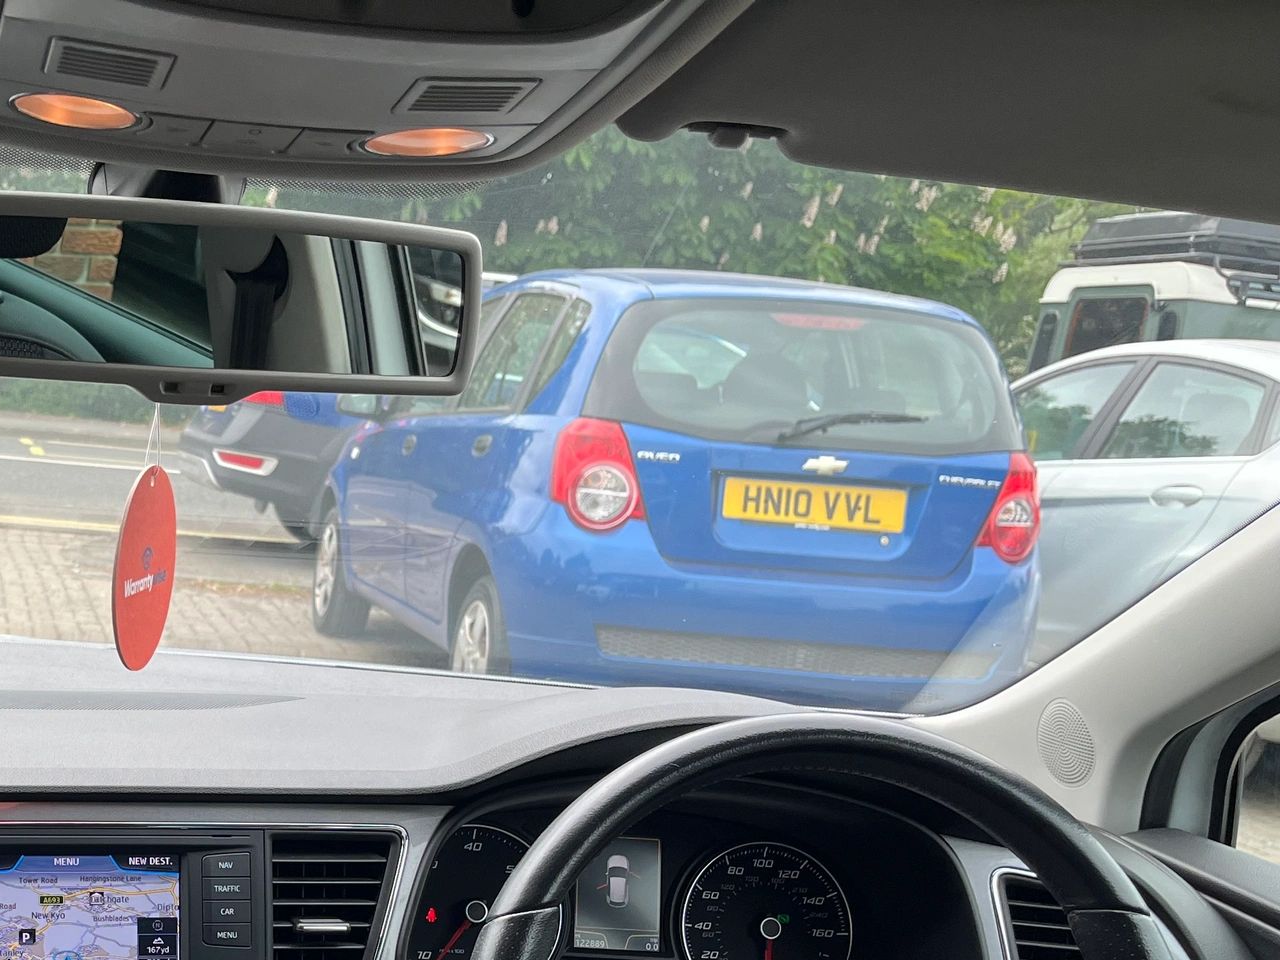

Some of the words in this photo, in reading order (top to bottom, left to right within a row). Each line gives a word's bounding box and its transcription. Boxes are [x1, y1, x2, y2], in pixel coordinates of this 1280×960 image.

[742, 484, 813, 518] HN10
[823, 490, 882, 525] VVL
[463, 842, 483, 852] 40
[53, 857, 80, 866] MENU
[128, 857, 148, 866] NEW
[149, 857, 173, 866] DEST.
[218, 861, 233, 869] NAV
[752, 859, 774, 868] 100
[505, 864, 516, 874] 5
[727, 866, 745, 875] 80
[778, 870, 800, 879] 120
[43, 896, 61, 904] A693
[702, 891, 720, 900] 60
[802, 896, 825, 905] 140
[0, 902, 17, 910] Road
[50, 912, 66, 921] Kyo
[694, 921, 712, 930] 40
[22, 932, 31, 943] P
[216, 931, 238, 939] MENU
[811, 929, 834, 938] 160
[645, 943, 659, 951] 0.0
[417, 951, 432, 960] 10
[701, 950, 719, 959] 20
